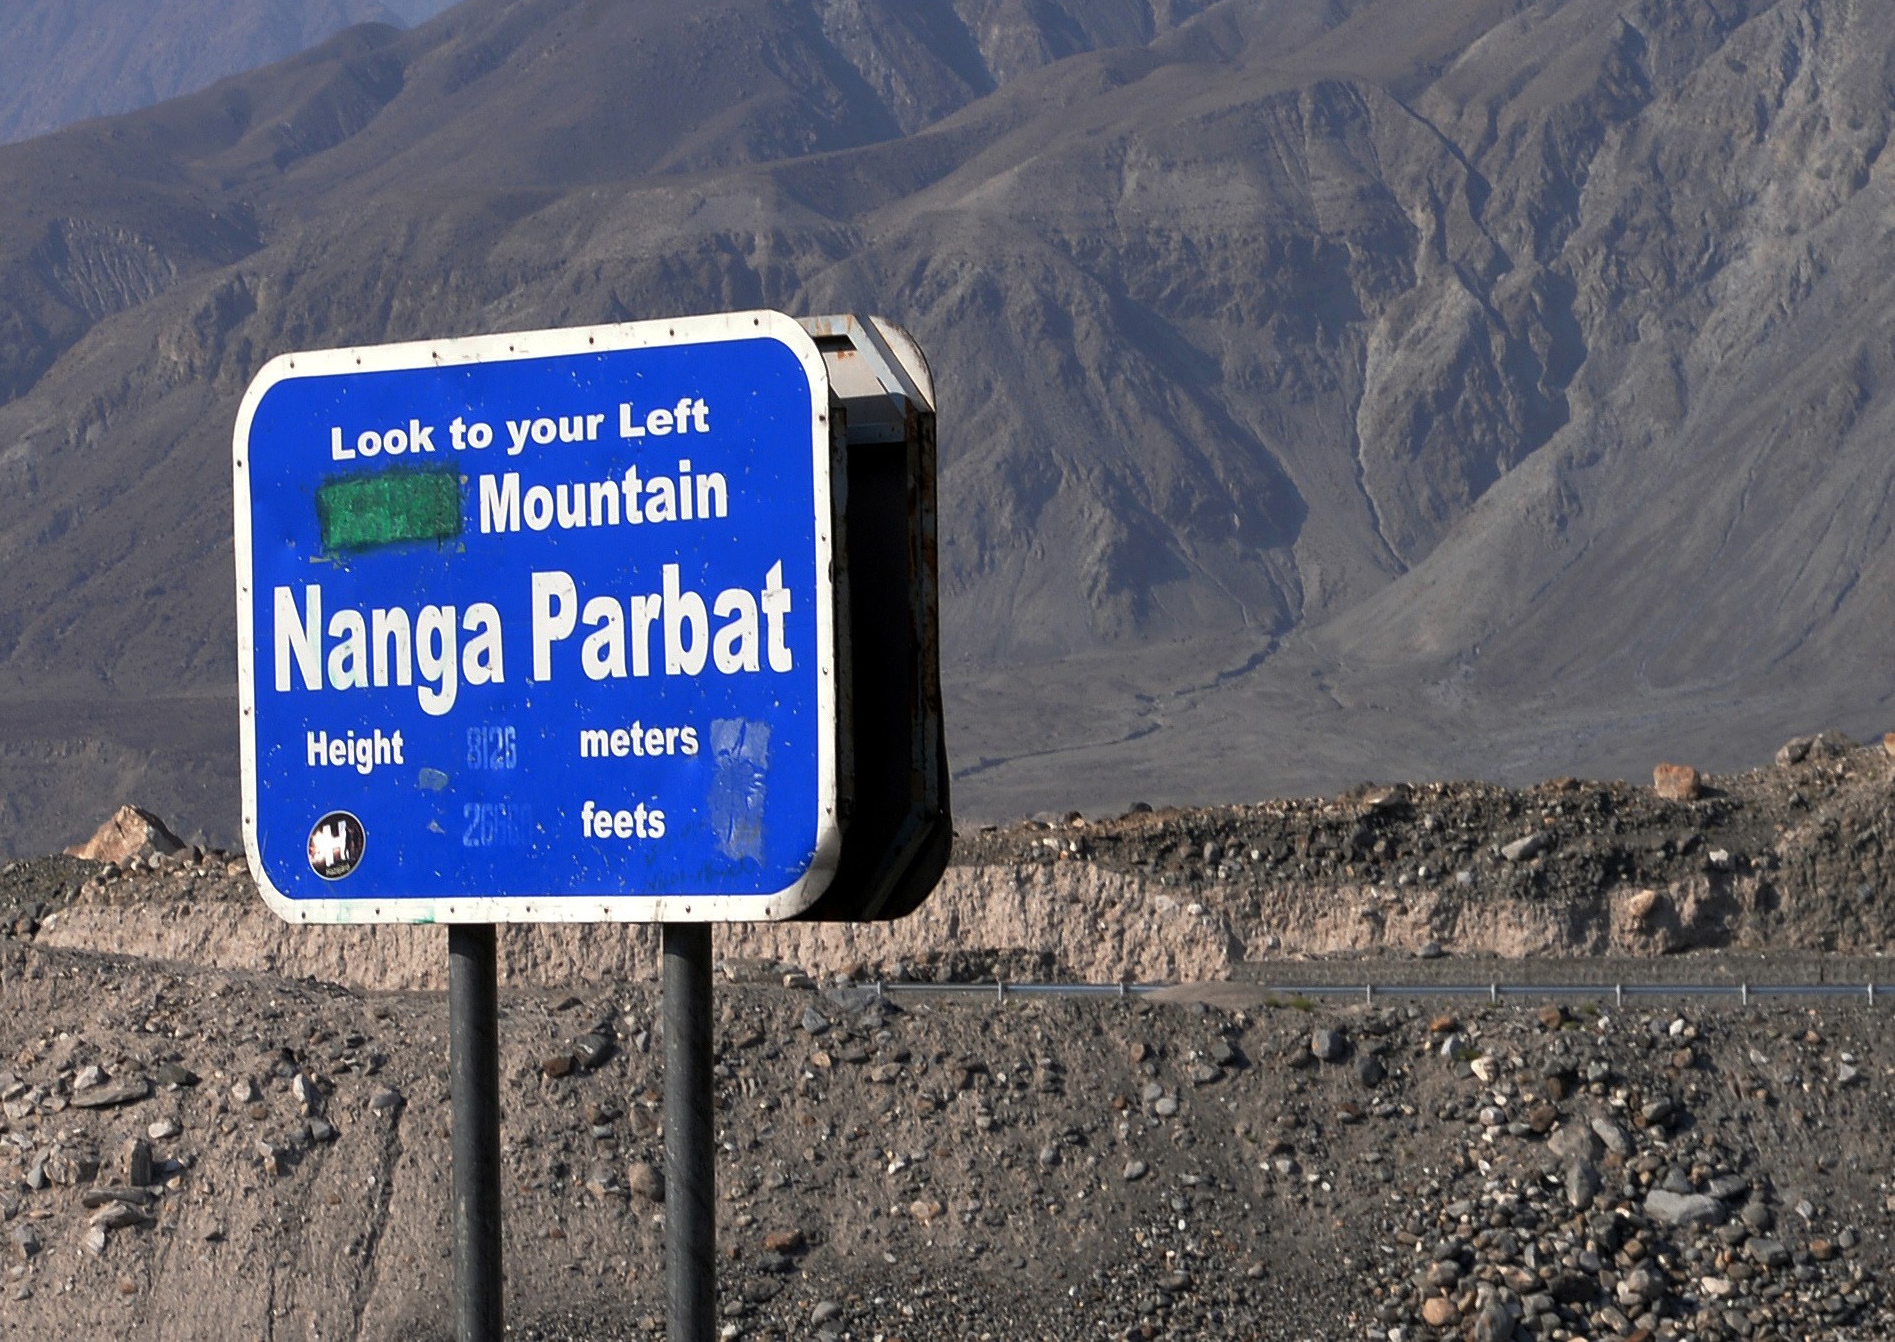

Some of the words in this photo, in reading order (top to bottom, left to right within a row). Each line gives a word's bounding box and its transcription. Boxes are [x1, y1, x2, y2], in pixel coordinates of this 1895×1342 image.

[331, 419, 436, 461] Look
[448, 416, 493, 451] to
[505, 413, 605, 456] your
[619, 397, 710, 438] Left
[479, 459, 728, 534] Mountain
[273, 584, 505, 716] Nanga
[531, 559, 793, 682] Parbat
[307, 728, 404, 775] Height
[580, 720, 699, 758] meters
[581, 800, 666, 839] feets
